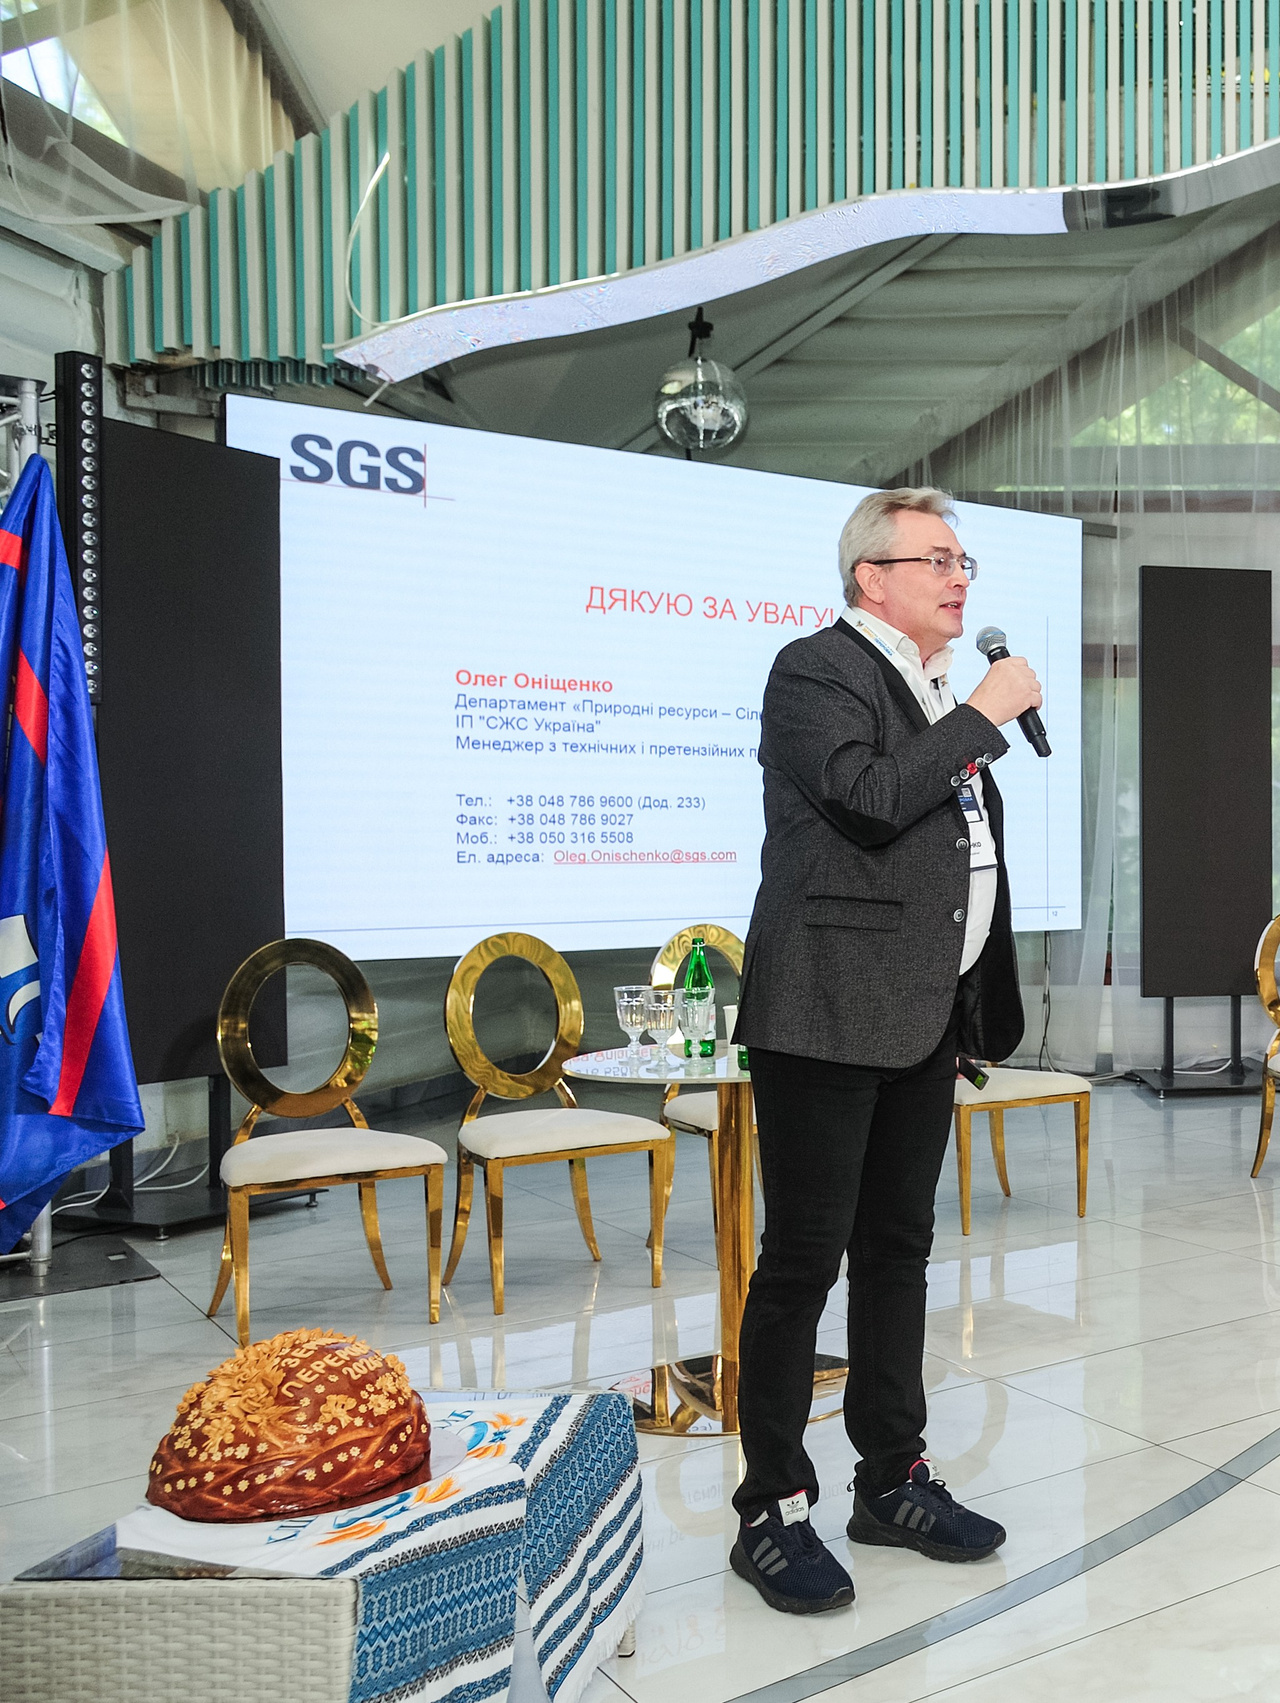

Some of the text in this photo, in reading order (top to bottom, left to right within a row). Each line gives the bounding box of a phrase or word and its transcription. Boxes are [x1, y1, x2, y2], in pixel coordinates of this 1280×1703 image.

[289, 433, 425, 495] SGS
[585, 586, 693, 616] ДЯКУЮ
[702, 596, 737, 620] ЗА
[455, 669, 613, 693] Олег Оніщенко
[454, 693, 566, 714] Департамент
[572, 699, 654, 718] «Природні
[658, 705, 718, 721] ресурси
[455, 714, 601, 735] ІП "СЖС Україна"
[455, 735, 544, 754] Менеджер
[549, 741, 557, 752] з
[562, 739, 637, 755] технічних
[649, 743, 745, 758] претензійних
[455, 793, 706, 811] Тел.: +38 048 786 9600 (Дод. 233)
[455, 813, 634, 826] Факс: +38 048 786 9027
[456, 831, 634, 845] Моб.: +38 050 316 5508
[456, 848, 737, 866] Ел. адреса: Oleg.Onischenko@sgs.com
[784, 1506, 805, 1517] adidas
